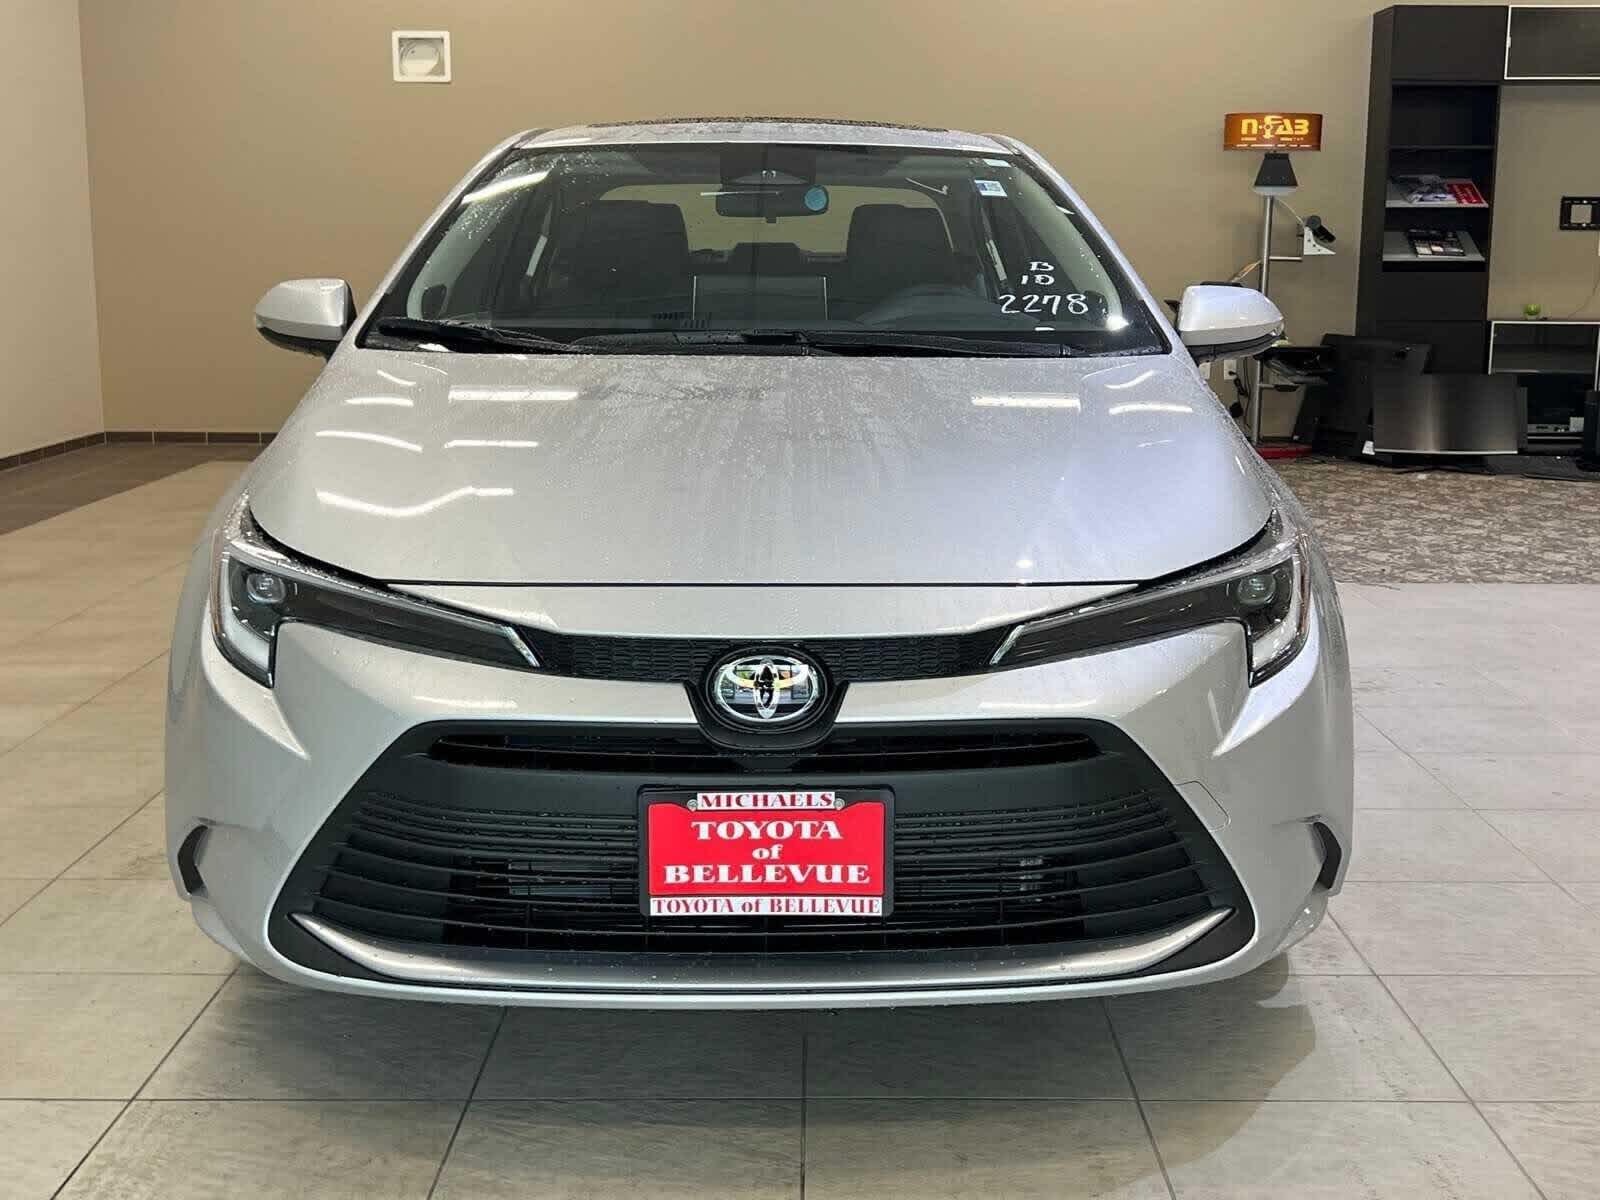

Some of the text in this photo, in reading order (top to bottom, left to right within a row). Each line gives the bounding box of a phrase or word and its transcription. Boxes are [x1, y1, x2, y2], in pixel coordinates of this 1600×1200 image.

[998, 294, 1089, 315] 2278
[701, 793, 833, 808] MICHAELS
[691, 820, 843, 840] TOYOTA
[752, 843, 783, 860] of
[664, 864, 871, 884] BELLEVUE
[652, 898, 880, 914] TOYOTA of BELLEVUE
